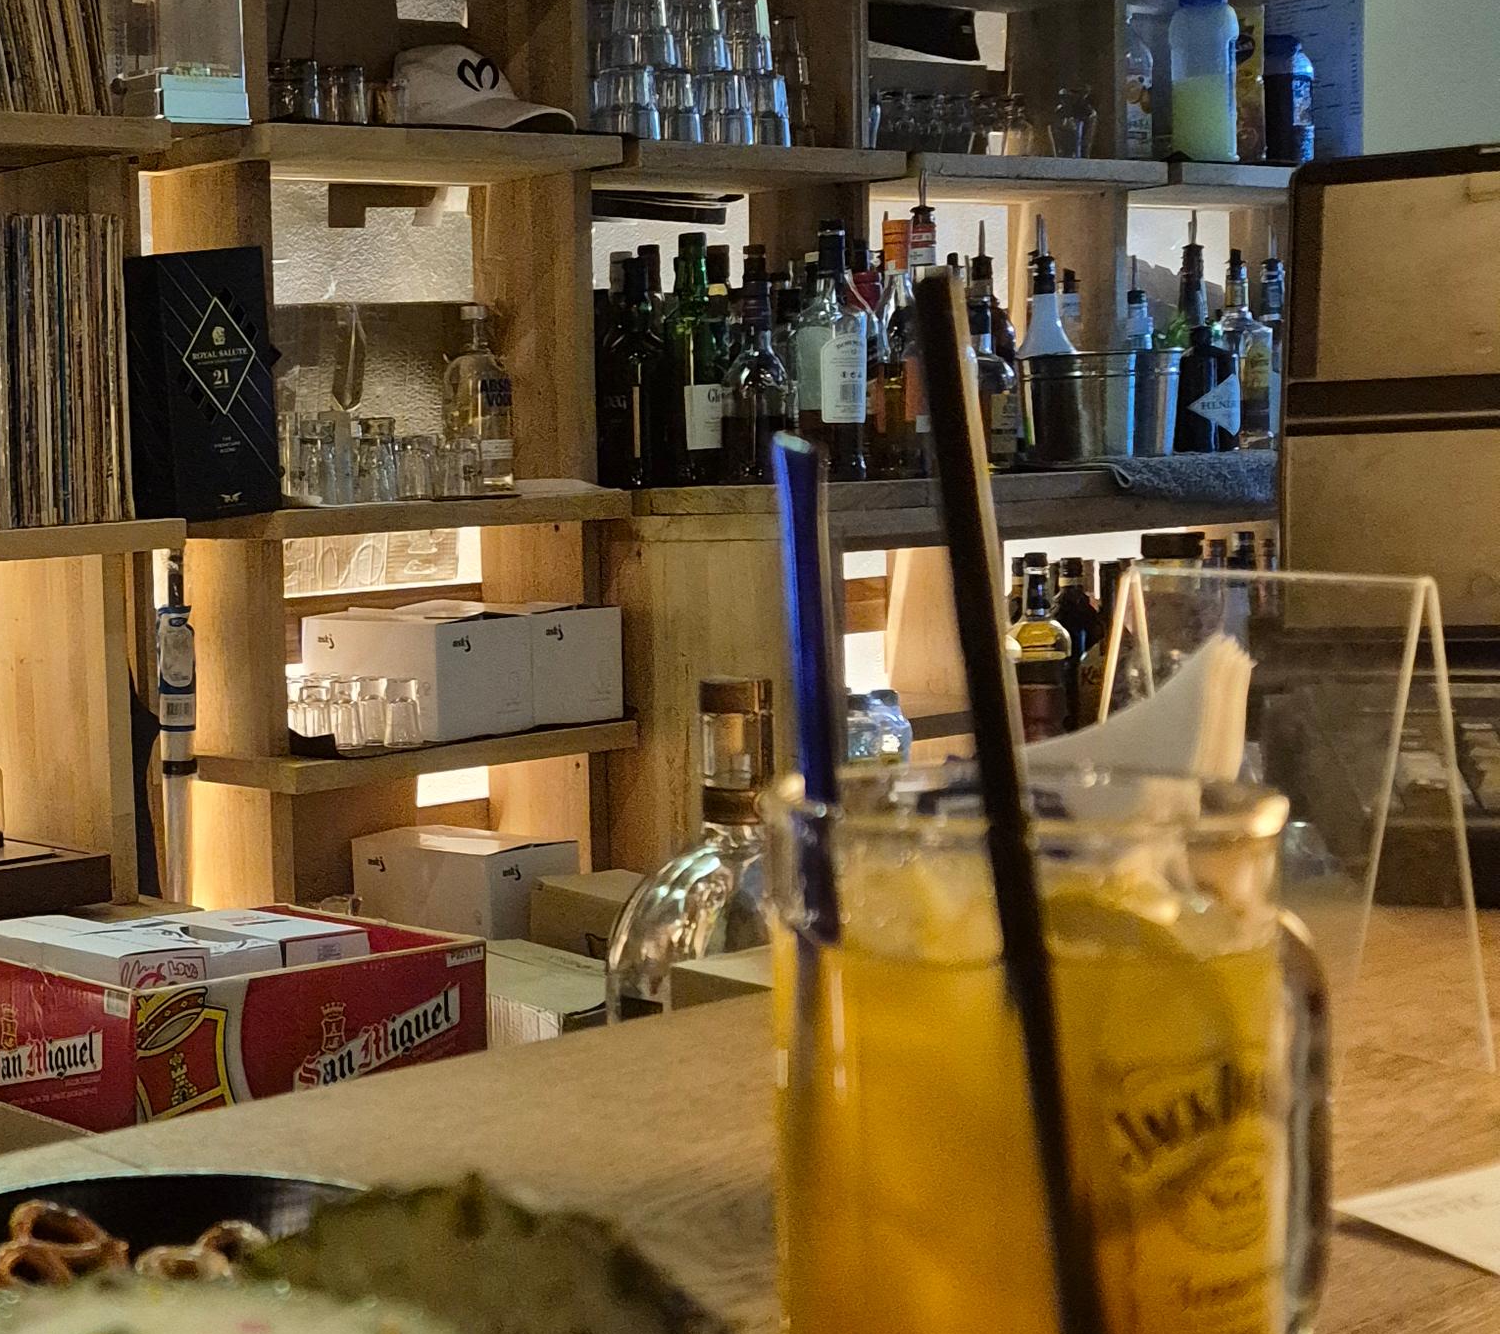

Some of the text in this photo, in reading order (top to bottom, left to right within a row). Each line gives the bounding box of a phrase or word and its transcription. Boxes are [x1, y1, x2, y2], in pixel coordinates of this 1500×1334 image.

[191, 347, 249, 360] ROYAL SALUTE
[212, 368, 230, 386] 21
[25, 1030, 96, 1078] Miguel
[298, 989, 452, 1087] San Miguel
